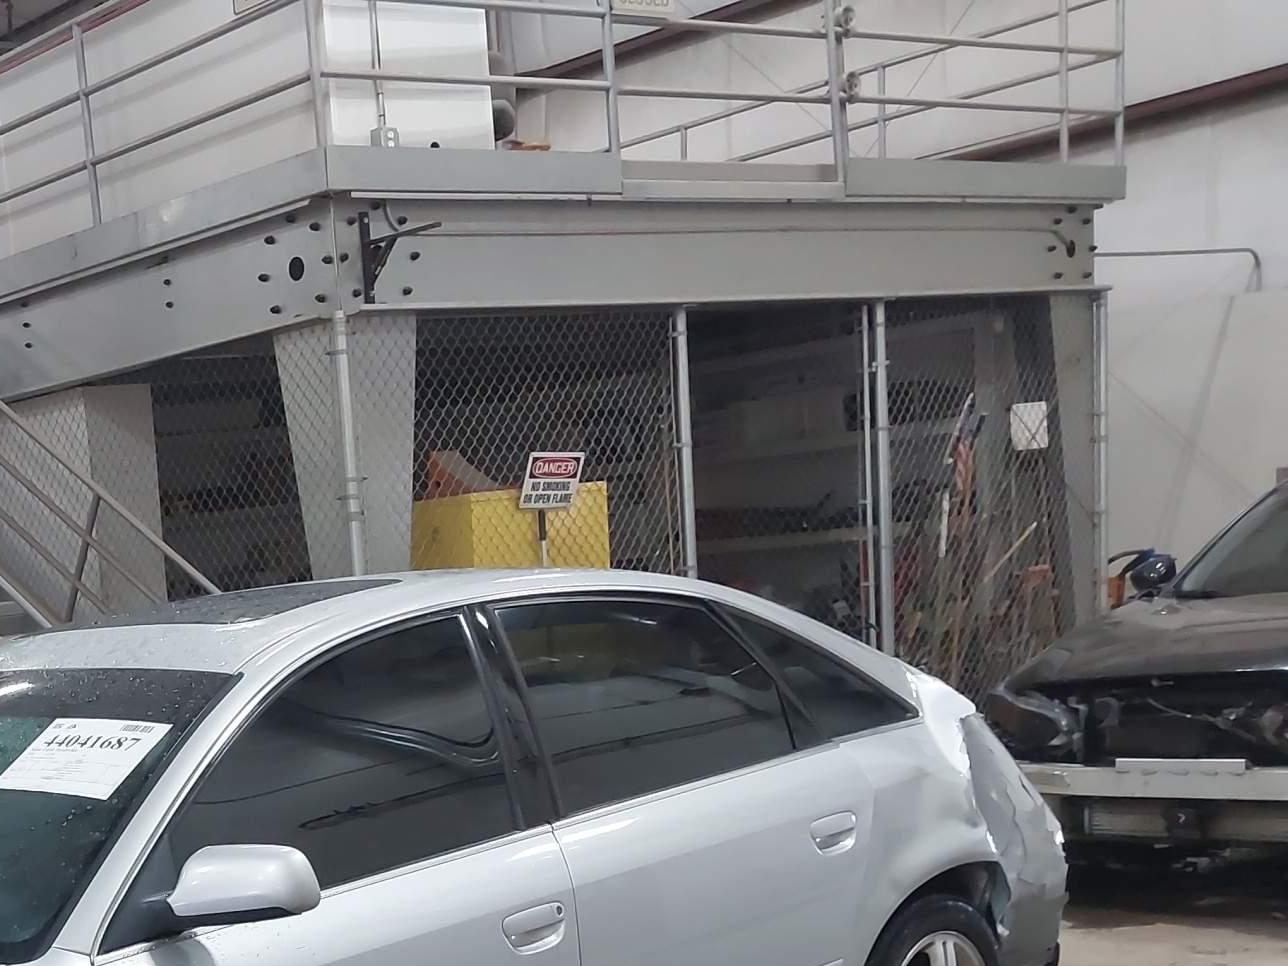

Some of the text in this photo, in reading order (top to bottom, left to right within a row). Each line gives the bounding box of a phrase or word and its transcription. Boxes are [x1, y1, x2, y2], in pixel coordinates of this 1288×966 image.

[535, 462, 574, 474] DANGER
[531, 481, 571, 492] NO SMOKING
[523, 493, 573, 503] OR OPEN FLAME
[43, 734, 142, 751] 44041687
